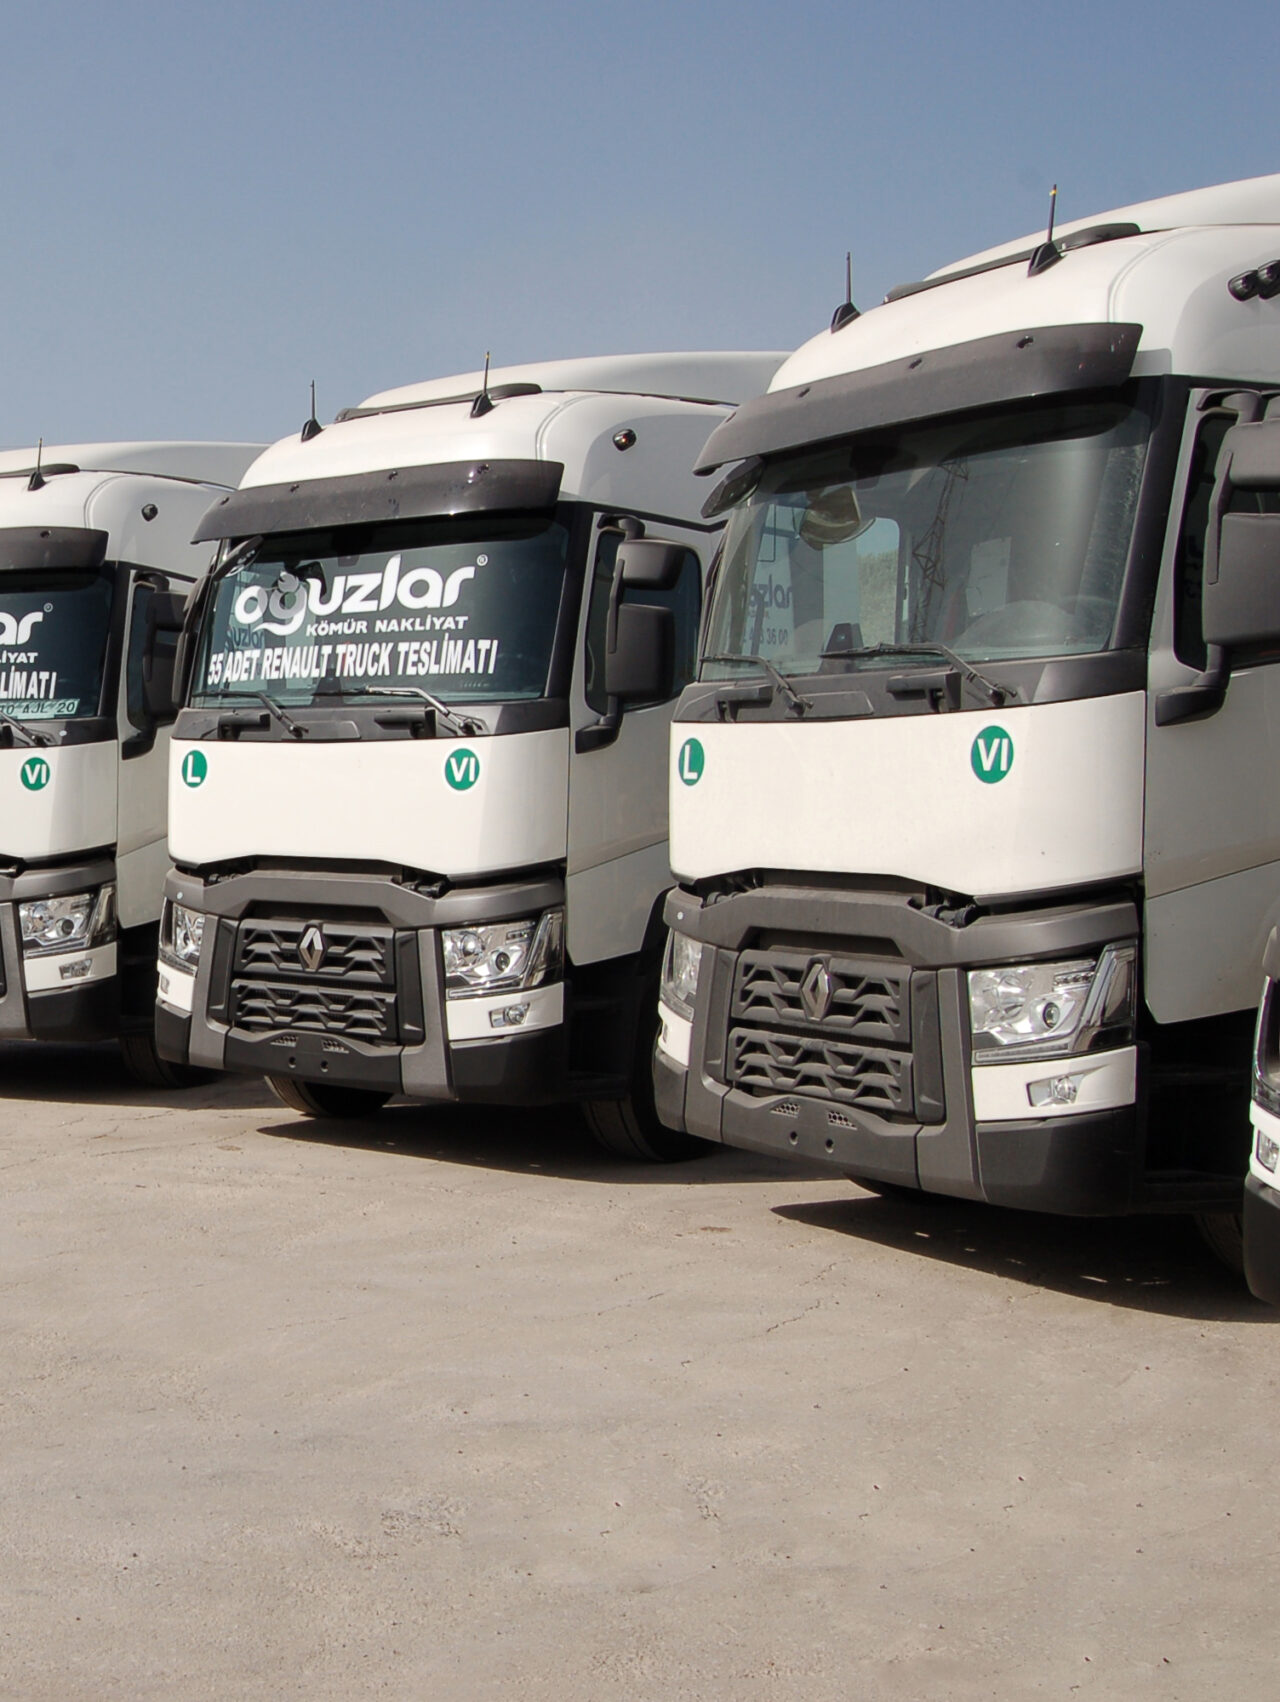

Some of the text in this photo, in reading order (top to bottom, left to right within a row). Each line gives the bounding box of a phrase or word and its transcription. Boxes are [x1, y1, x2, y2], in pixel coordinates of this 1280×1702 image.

[306, 614, 468, 637] KÖMÜR NAKLİYAT
[207, 633, 499, 686] 55 ADET RENAULT TRUCK TESLİMATI
[57, 702, 75, 713] 20
[684, 744, 698, 780] L
[978, 737, 1008, 772] VI
[25, 764, 47, 785] VI
[187, 755, 201, 783] L
[450, 757, 476, 783] VI
